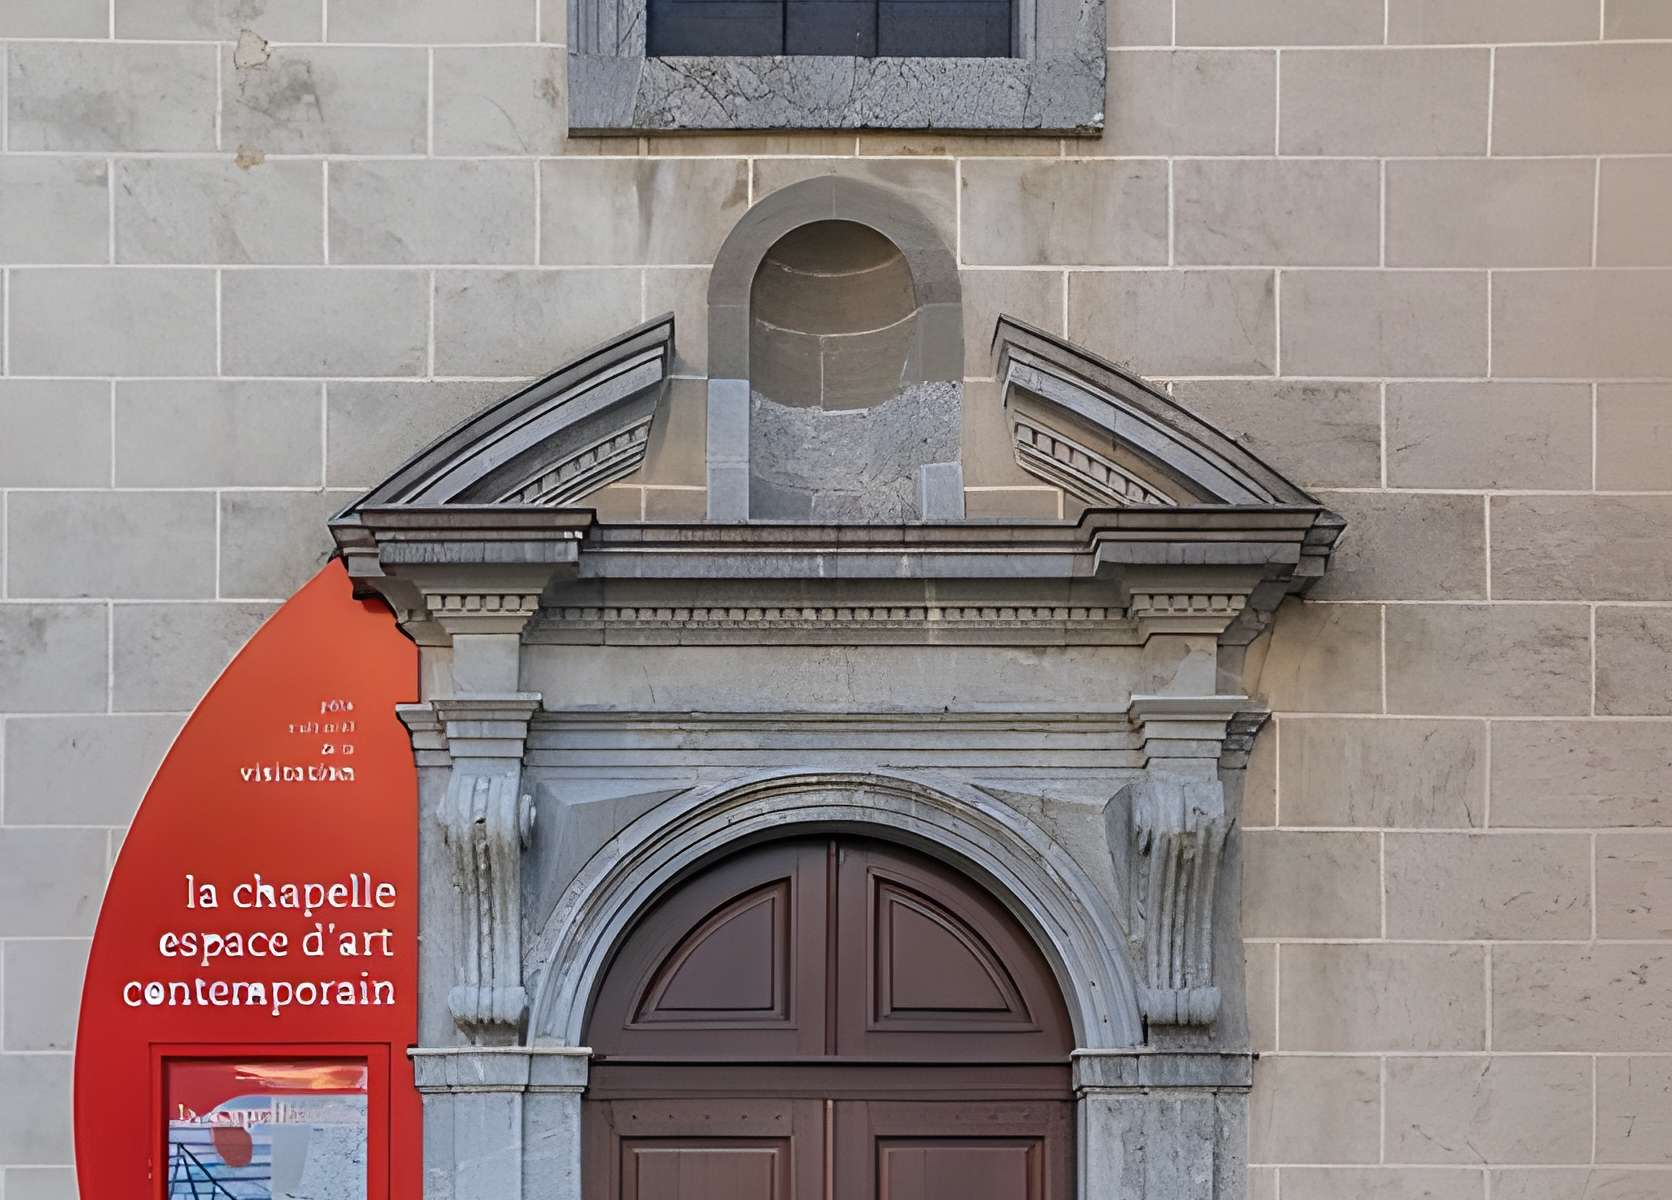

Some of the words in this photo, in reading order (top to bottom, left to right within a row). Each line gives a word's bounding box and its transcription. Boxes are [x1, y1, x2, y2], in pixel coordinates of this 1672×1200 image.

[186, 874, 218, 908] la
[232, 873, 397, 917] chapelle
[159, 931, 289, 967] espace
[302, 922, 394, 957] d'art
[122, 971, 396, 1016] contemporain
